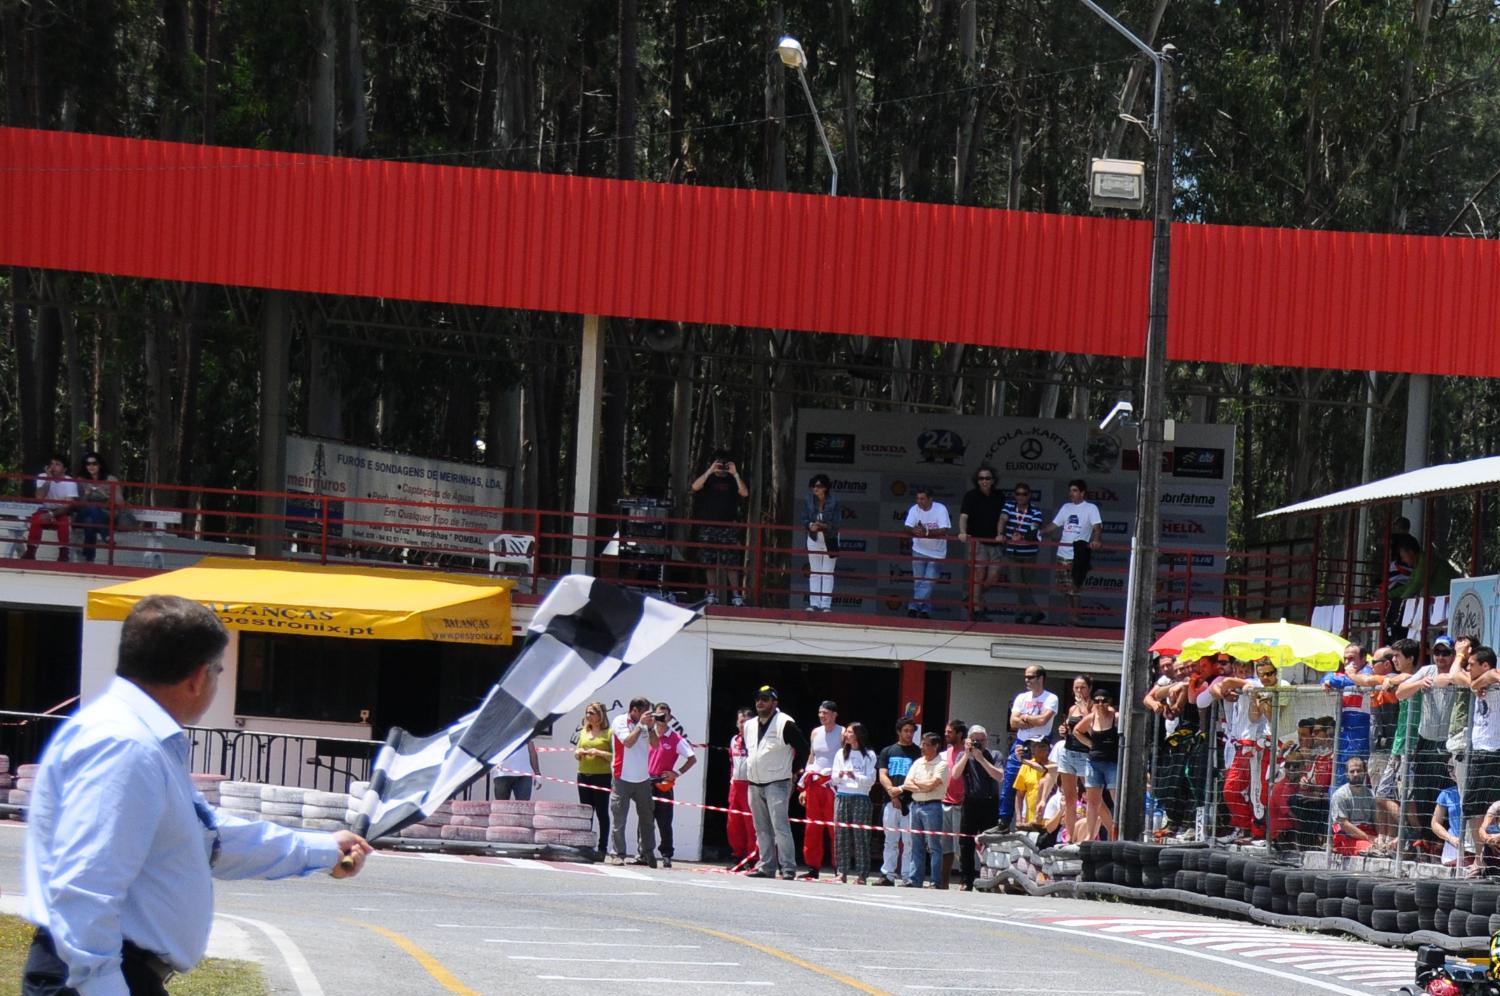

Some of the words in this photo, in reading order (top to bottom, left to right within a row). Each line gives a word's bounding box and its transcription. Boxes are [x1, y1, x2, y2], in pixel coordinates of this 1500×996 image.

[925, 432, 952, 449] 24
[985, 428, 1023, 461] SCOLA
[861, 444, 907, 453] HONDA
[337, 454, 366, 467] FUROS
[367, 459, 373, 470] E
[374, 461, 425, 480] SONDAGENS
[427, 470, 438, 480] DE
[440, 471, 484, 488] MEIRINHAS,
[485, 478, 503, 490] LDA.
[1006, 462, 1058, 471] EUROINDY
[442, 490, 451, 500] de
[1087, 490, 1119, 501] ELIX
[384, 507, 396, 518] Em
[397, 509, 433, 524] Qualquer
[433, 514, 449, 527] Tipo
[450, 517, 460, 526] de
[1162, 523, 1205, 533] HELIX
[454, 534, 484, 546] POMBAL
[209, 602, 334, 621] ALANÇAS
